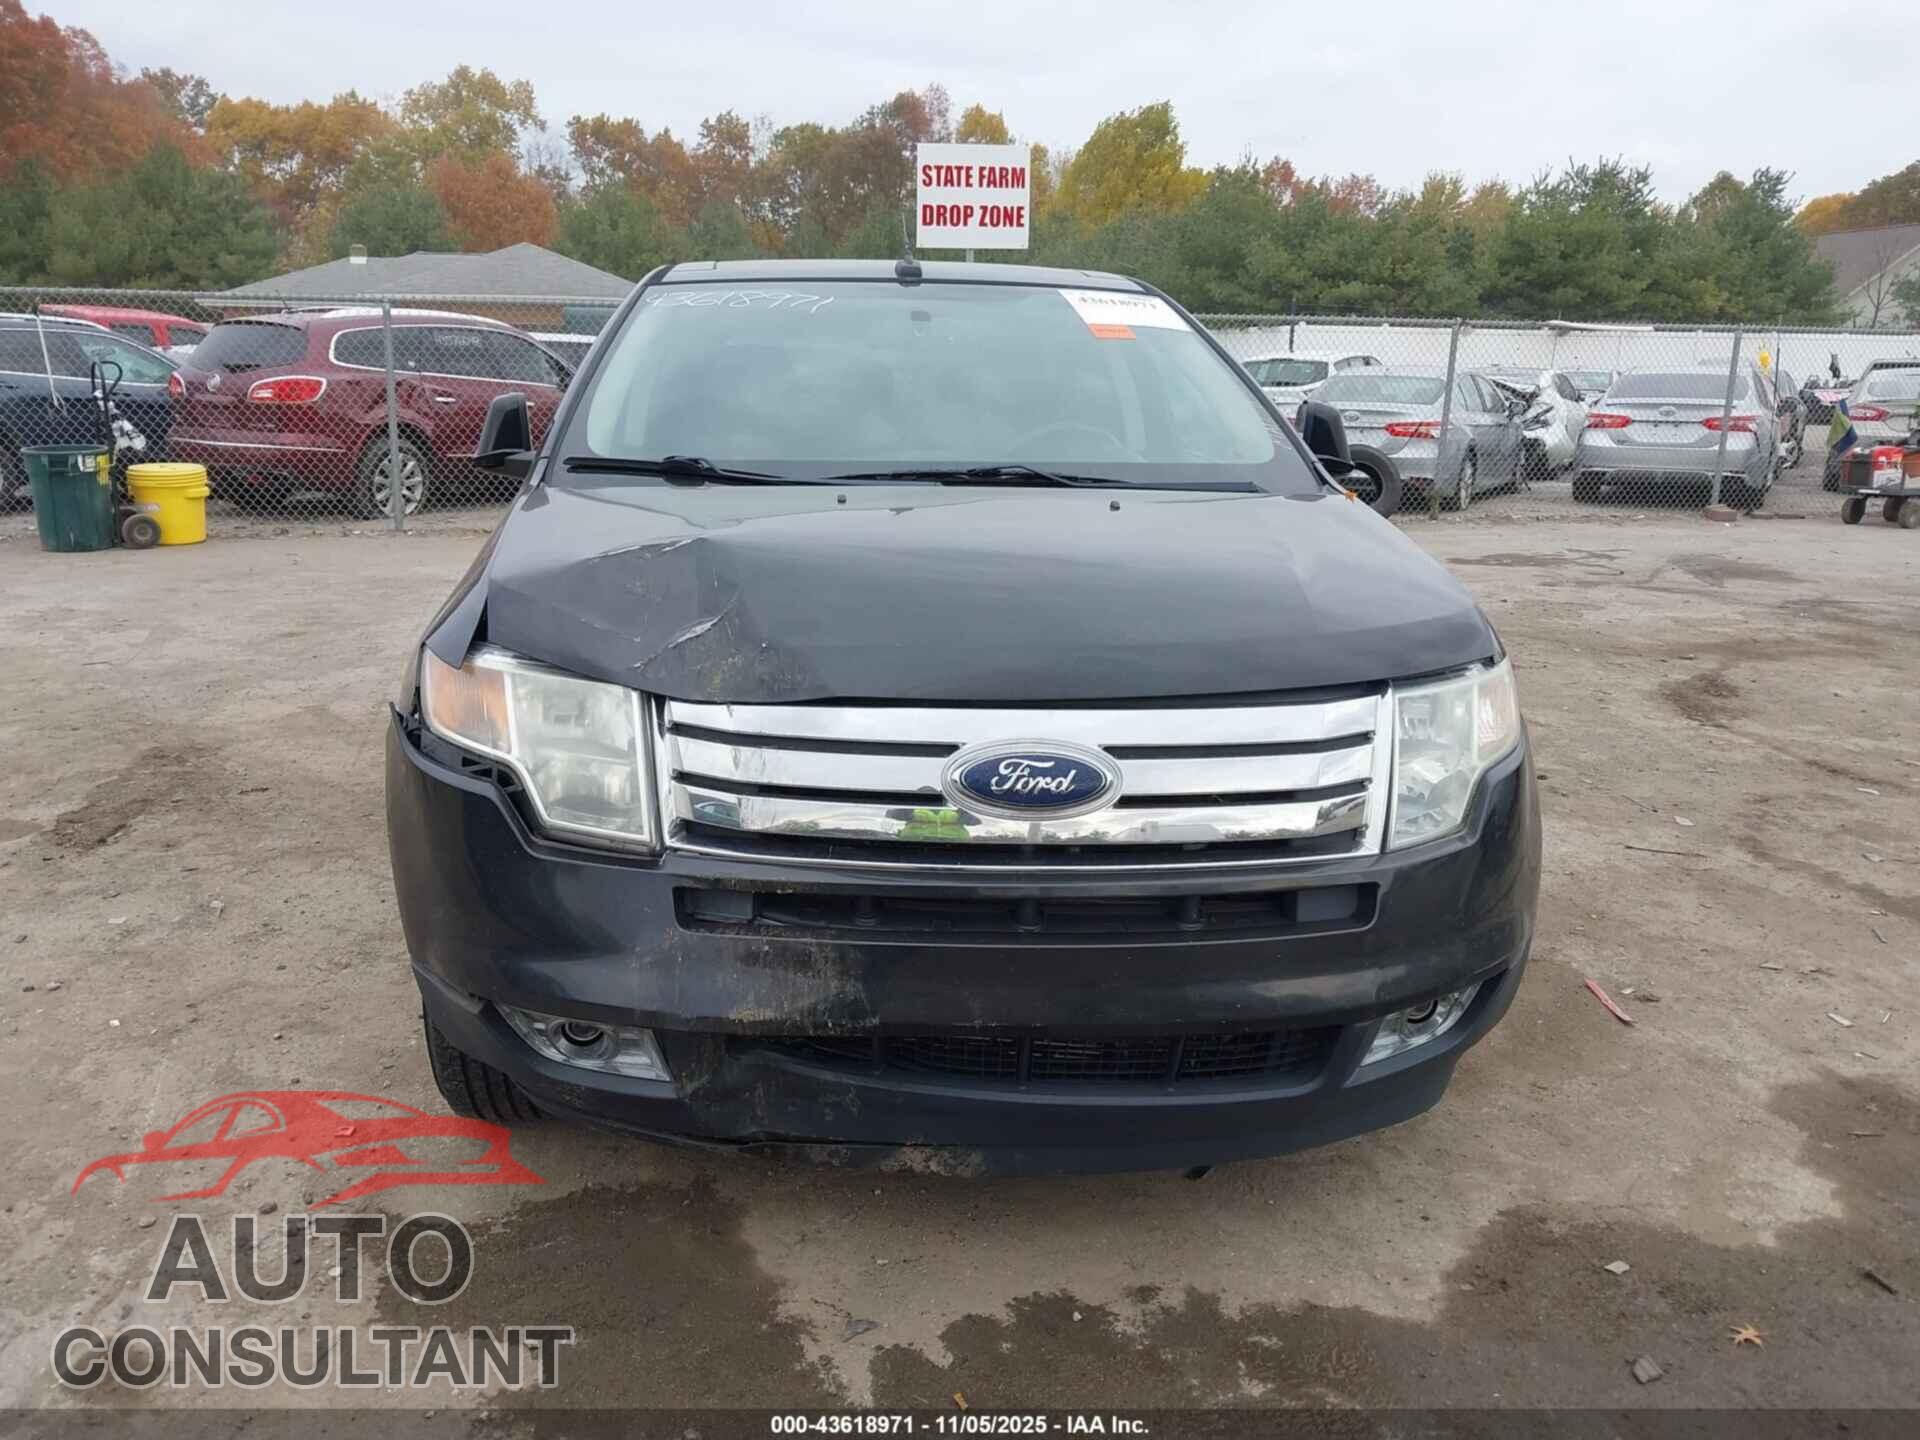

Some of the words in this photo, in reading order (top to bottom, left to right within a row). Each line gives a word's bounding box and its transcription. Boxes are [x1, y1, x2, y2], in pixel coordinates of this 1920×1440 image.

[922, 164, 973, 188] STATE
[978, 165, 1026, 189] FARM
[921, 204, 974, 227] DROP
[978, 205, 1025, 228] ZONE
[990, 758, 1077, 794] Ford
